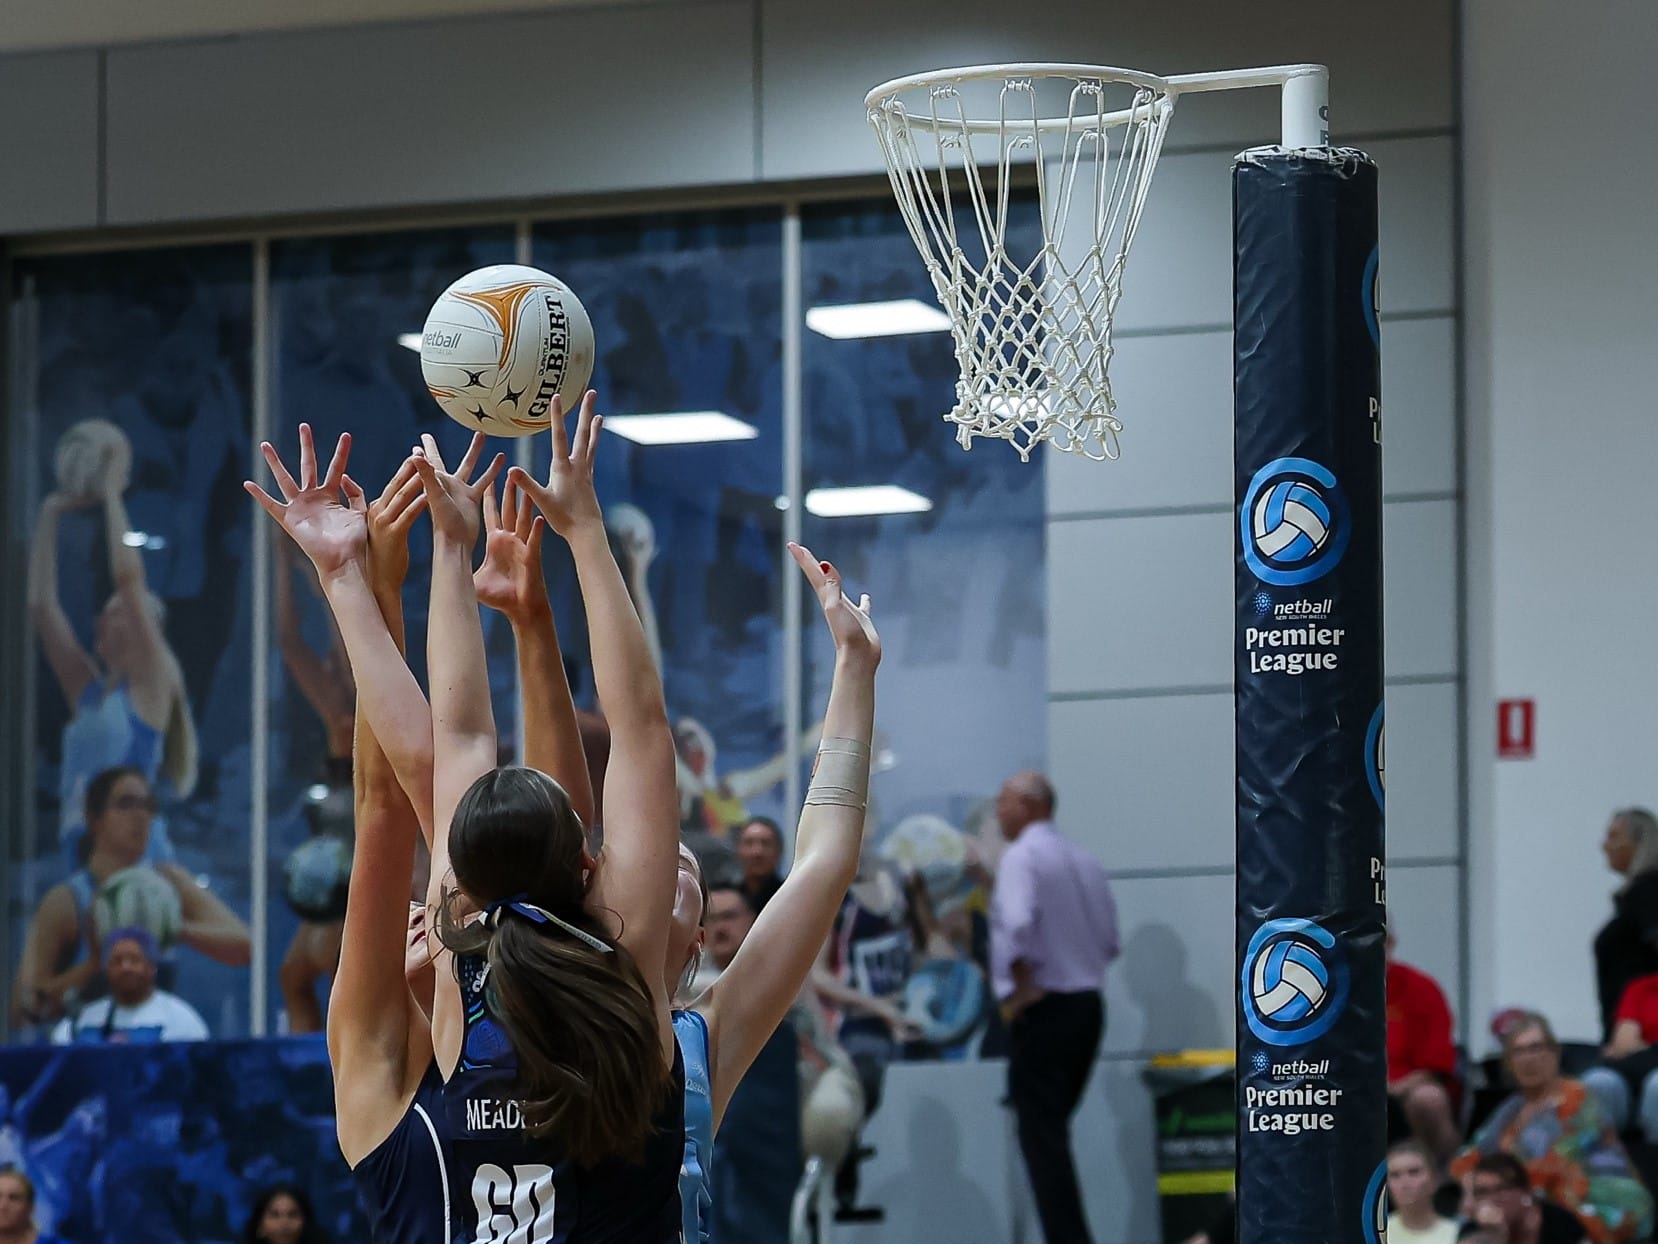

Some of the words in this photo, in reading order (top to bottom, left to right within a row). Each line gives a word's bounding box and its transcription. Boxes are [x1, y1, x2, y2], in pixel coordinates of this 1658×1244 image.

[528, 295, 567, 417] GILBERT
[1274, 598, 1333, 615] netball
[1246, 623, 1345, 651] Premier
[1250, 651, 1338, 675] League
[1272, 1059, 1330, 1075] netball
[1246, 1083, 1343, 1109] Premier
[466, 1098, 526, 1131] MEAD
[1249, 1110, 1335, 1135] League
